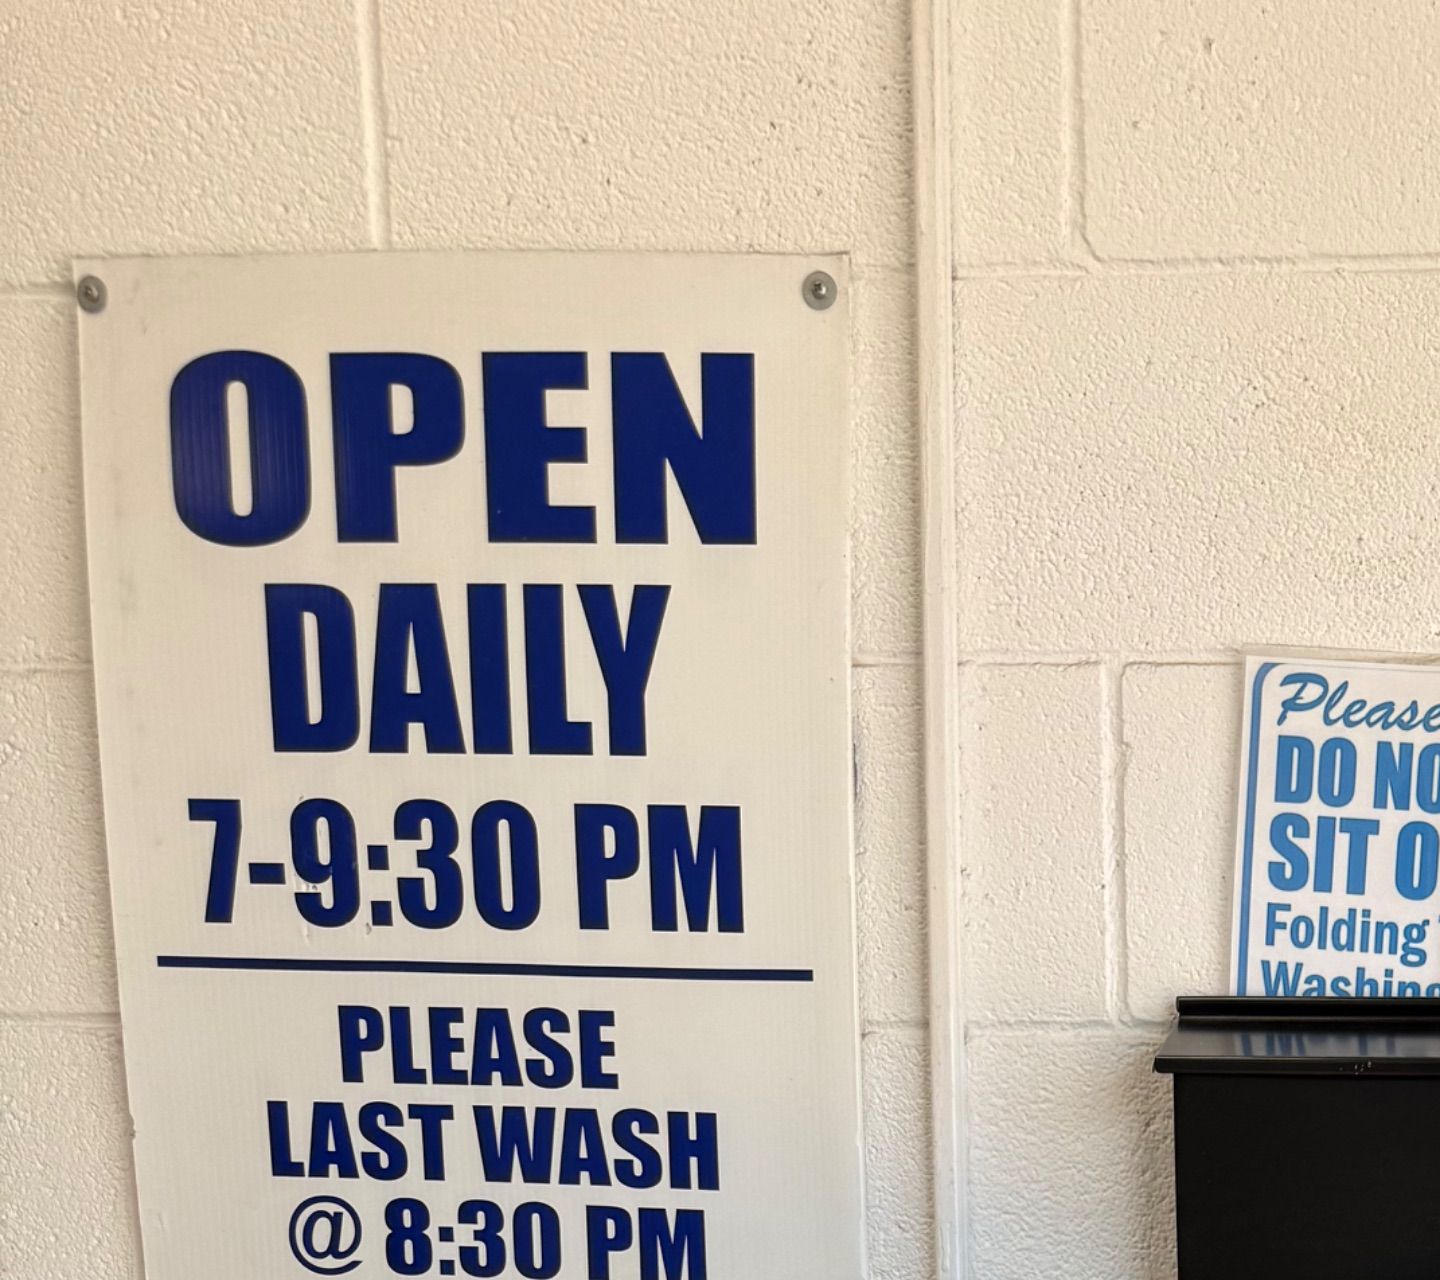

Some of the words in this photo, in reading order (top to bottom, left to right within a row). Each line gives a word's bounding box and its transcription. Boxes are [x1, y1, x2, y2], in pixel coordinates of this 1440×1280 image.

[169, 349, 757, 548] OPEN
[263, 582, 672, 757] DAILY
[1274, 735, 1357, 808] DO
[187, 797, 541, 932] 7-9:30
[573, 803, 745, 934] PM
[1267, 812, 1380, 897] SIT
[1264, 903, 1430, 968] Folding
[337, 1004, 619, 1090] PLEASE
[266, 1100, 454, 1181] LAST
[472, 1104, 720, 1191] WASH
[288, 1195, 363, 1276] @
[384, 1197, 562, 1280] 8:30
